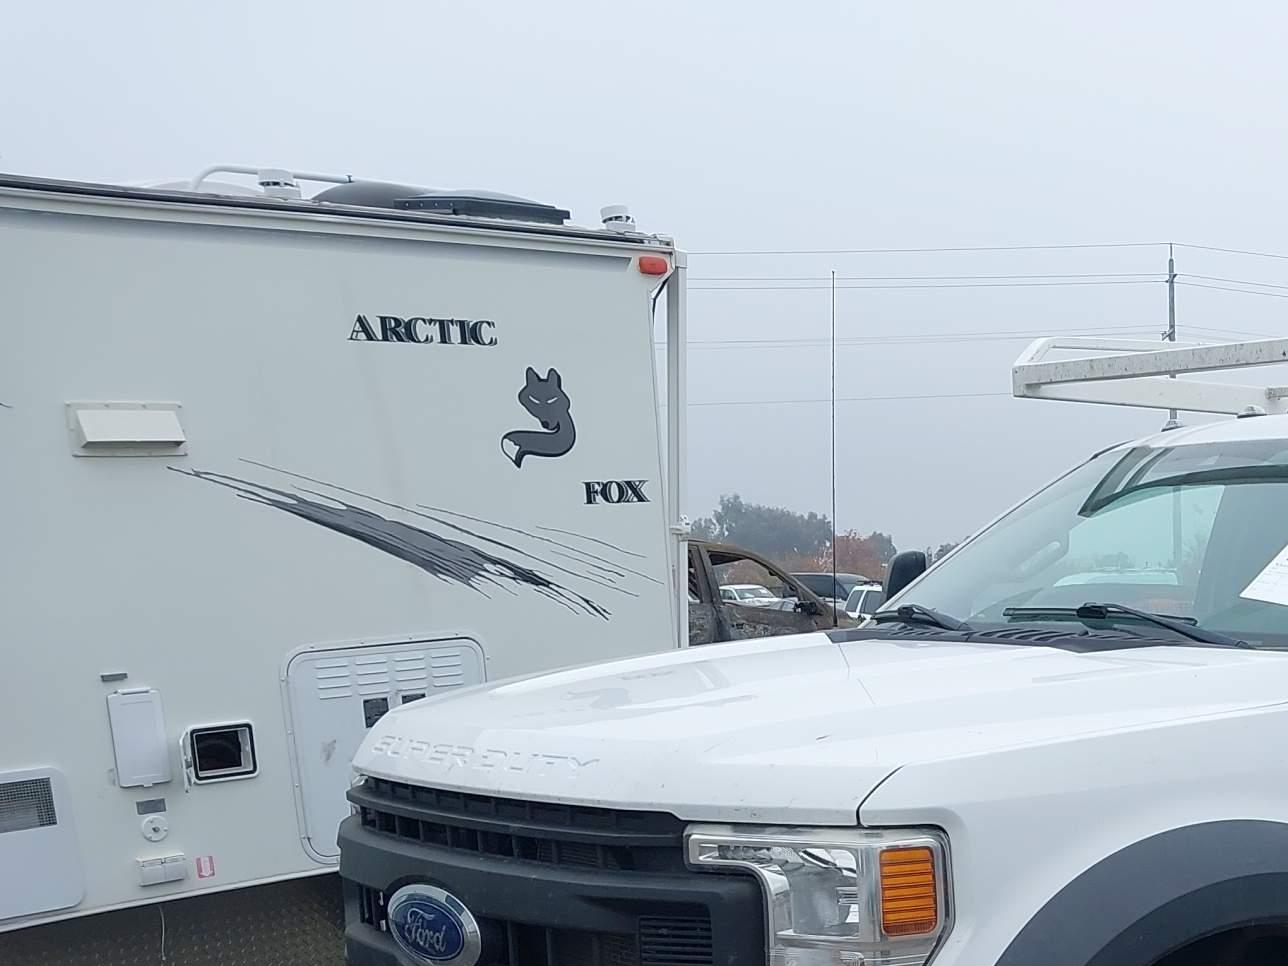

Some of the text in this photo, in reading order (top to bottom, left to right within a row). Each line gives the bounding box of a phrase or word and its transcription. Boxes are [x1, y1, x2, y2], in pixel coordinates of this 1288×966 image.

[347, 314, 498, 347] ARCTIC
[582, 479, 650, 505] FOX
[373, 735, 475, 767] SUPER
[404, 906, 448, 953] Ford
